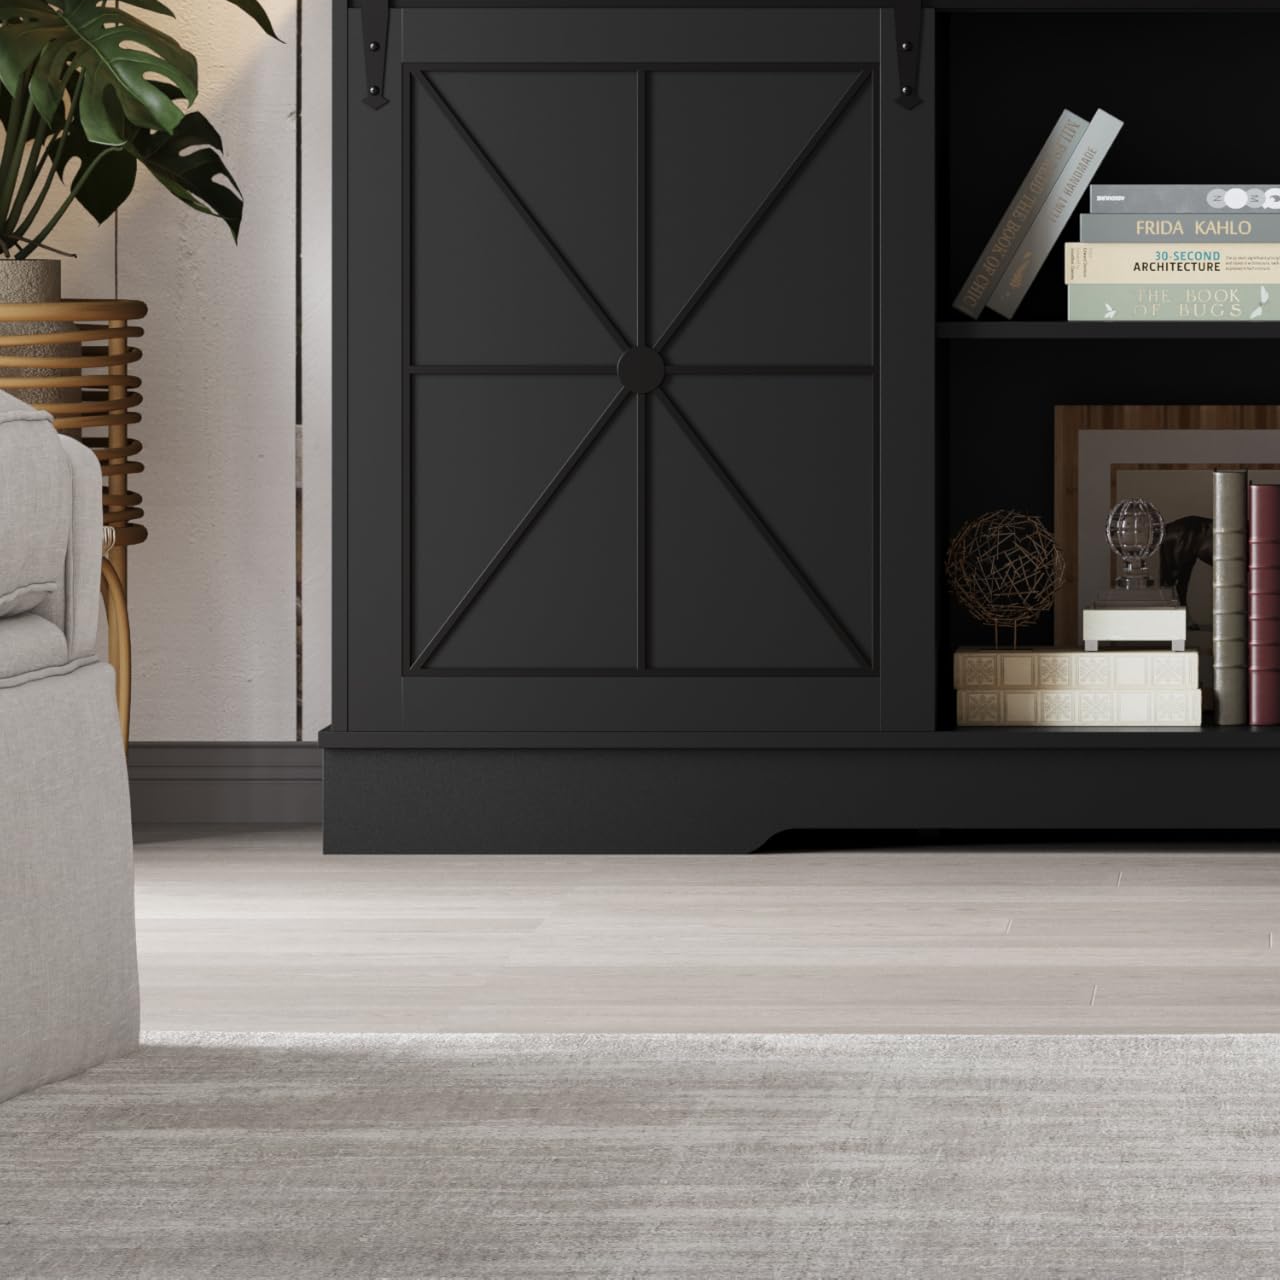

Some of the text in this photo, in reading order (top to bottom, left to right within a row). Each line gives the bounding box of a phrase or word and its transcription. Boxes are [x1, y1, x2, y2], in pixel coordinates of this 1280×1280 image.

[1061, 145, 1097, 197] HANDMADE
[1136, 219, 1252, 236] FRIDA KAHLO
[1155, 251, 1221, 261] 30-SECOND
[1133, 262, 1221, 272] ARCHITECTURE
[1136, 289, 1241, 303] THE BOOK
[1179, 303, 1243, 317] BUGS
